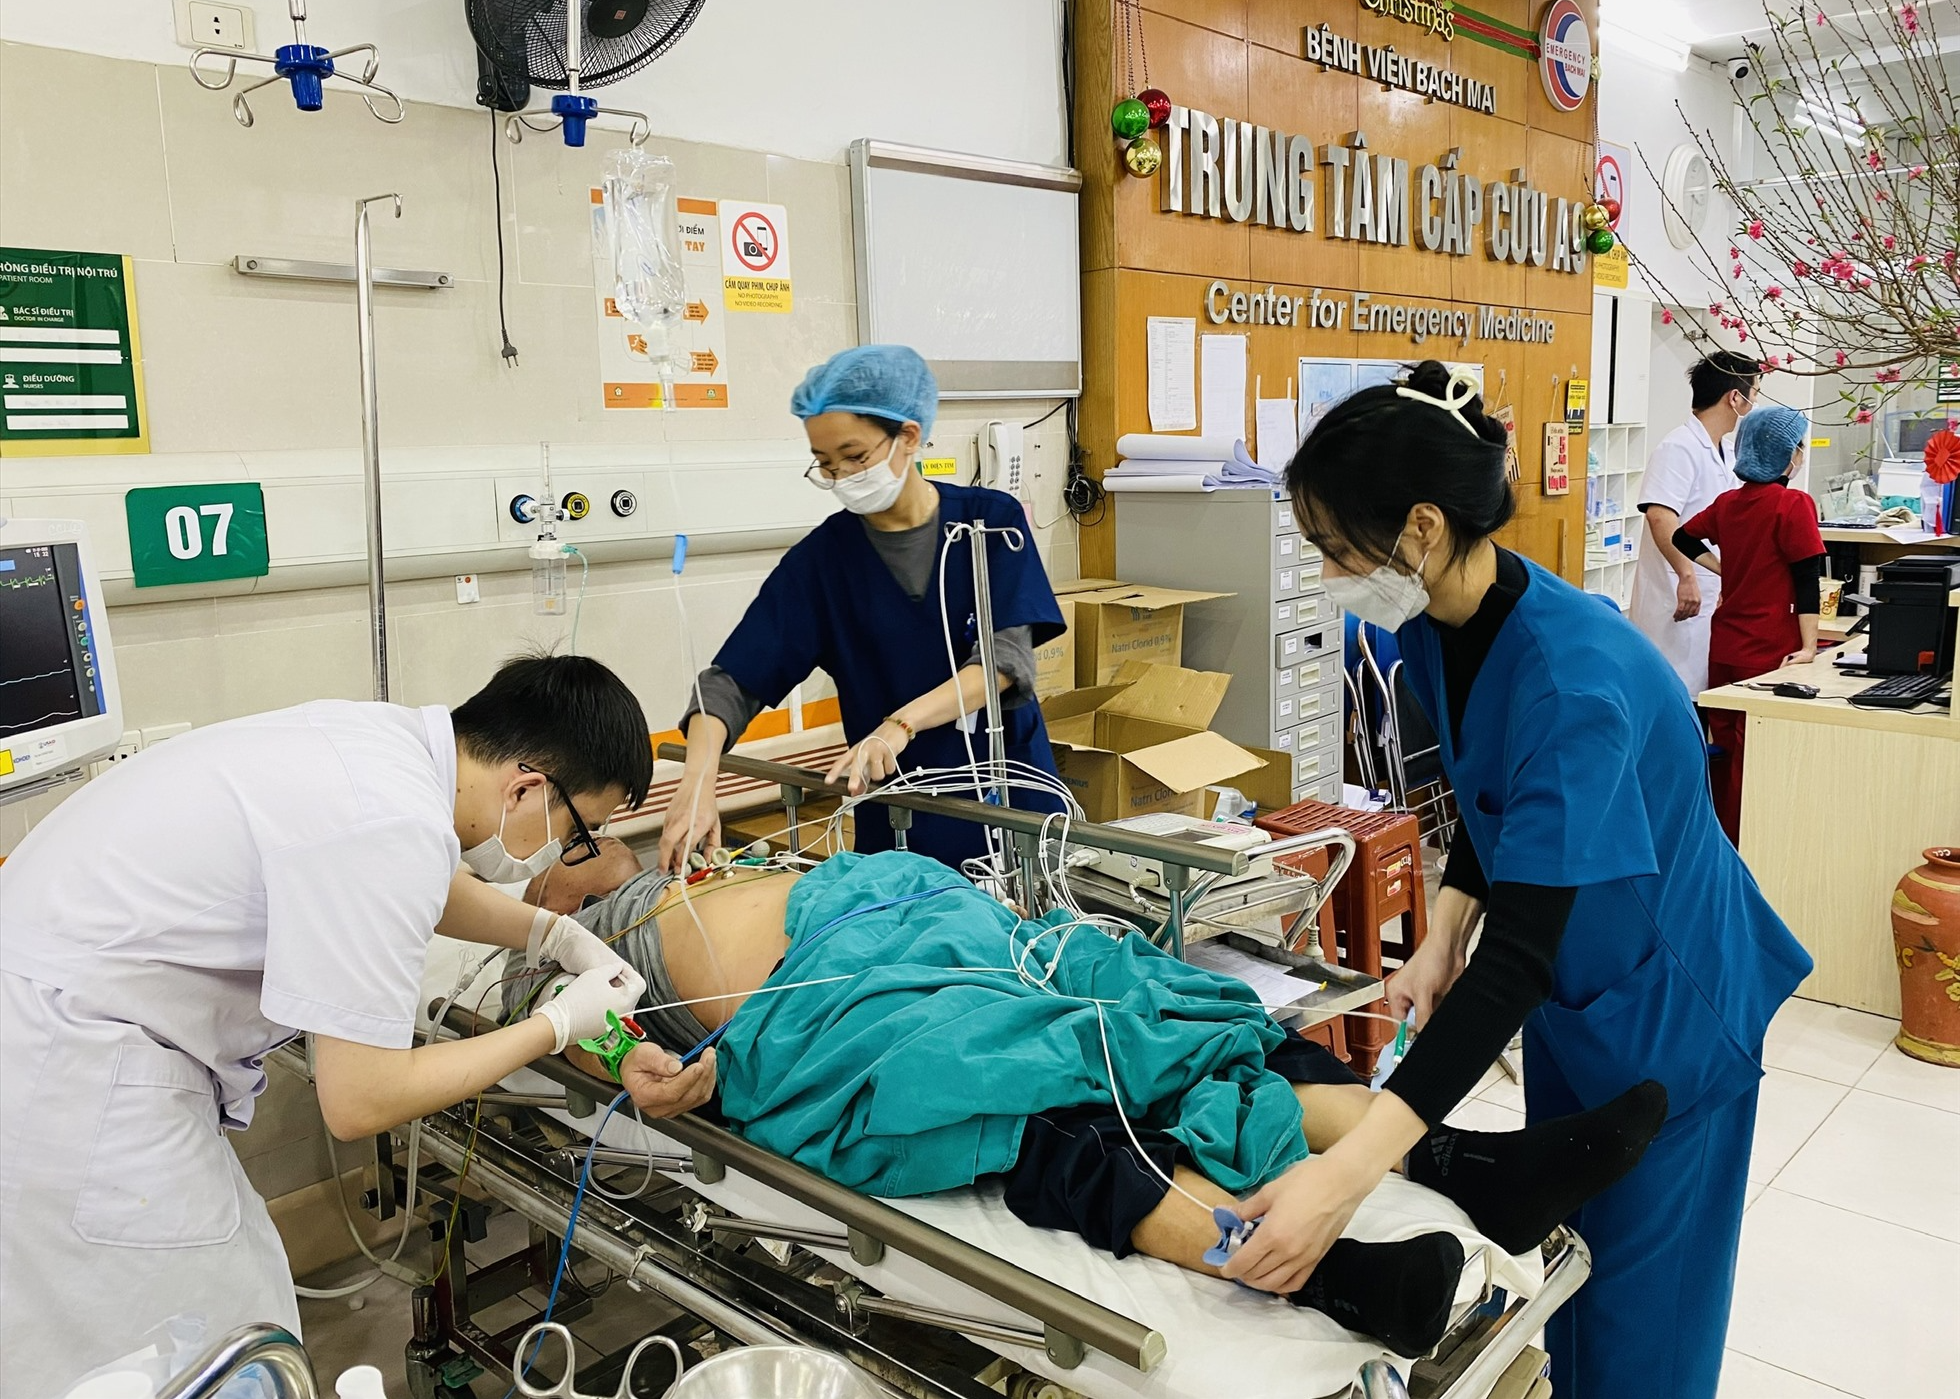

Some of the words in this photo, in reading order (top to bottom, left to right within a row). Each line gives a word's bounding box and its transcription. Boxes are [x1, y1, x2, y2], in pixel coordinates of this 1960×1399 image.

[1364, 0, 1454, 41] hristmas
[1546, 42, 1585, 64] EMERGENCY
[1306, 22, 1361, 74] BỆNH
[1367, 45, 1412, 91] VIỆN
[1416, 61, 1462, 103] BẠCH
[1467, 78, 1496, 114] MAI
[1163, 105, 1315, 232] TRUNG
[1322, 130, 1409, 246] TÂM
[1417, 147, 1482, 256] CẤP
[1488, 168, 1548, 267] CỨU
[1550, 197, 1586, 274] A9
[685, 240, 705, 252] TAY
[77, 266, 96, 279] NỘI
[97, 267, 118, 278] TRÚ
[29, 276, 53, 284] ROOM
[737, 280, 750, 291] QUAY
[13, 306, 30, 315] BÁC
[1206, 281, 1304, 327] Center
[1310, 288, 1347, 329] for
[1351, 292, 1472, 347] Emergency
[1476, 305, 1555, 344] Medicine
[165, 502, 234, 560] 07
[1043, 646, 1064, 661] 0,9%
[1111, 642, 1130, 654] Natri
[1130, 794, 1153, 808] Natri
